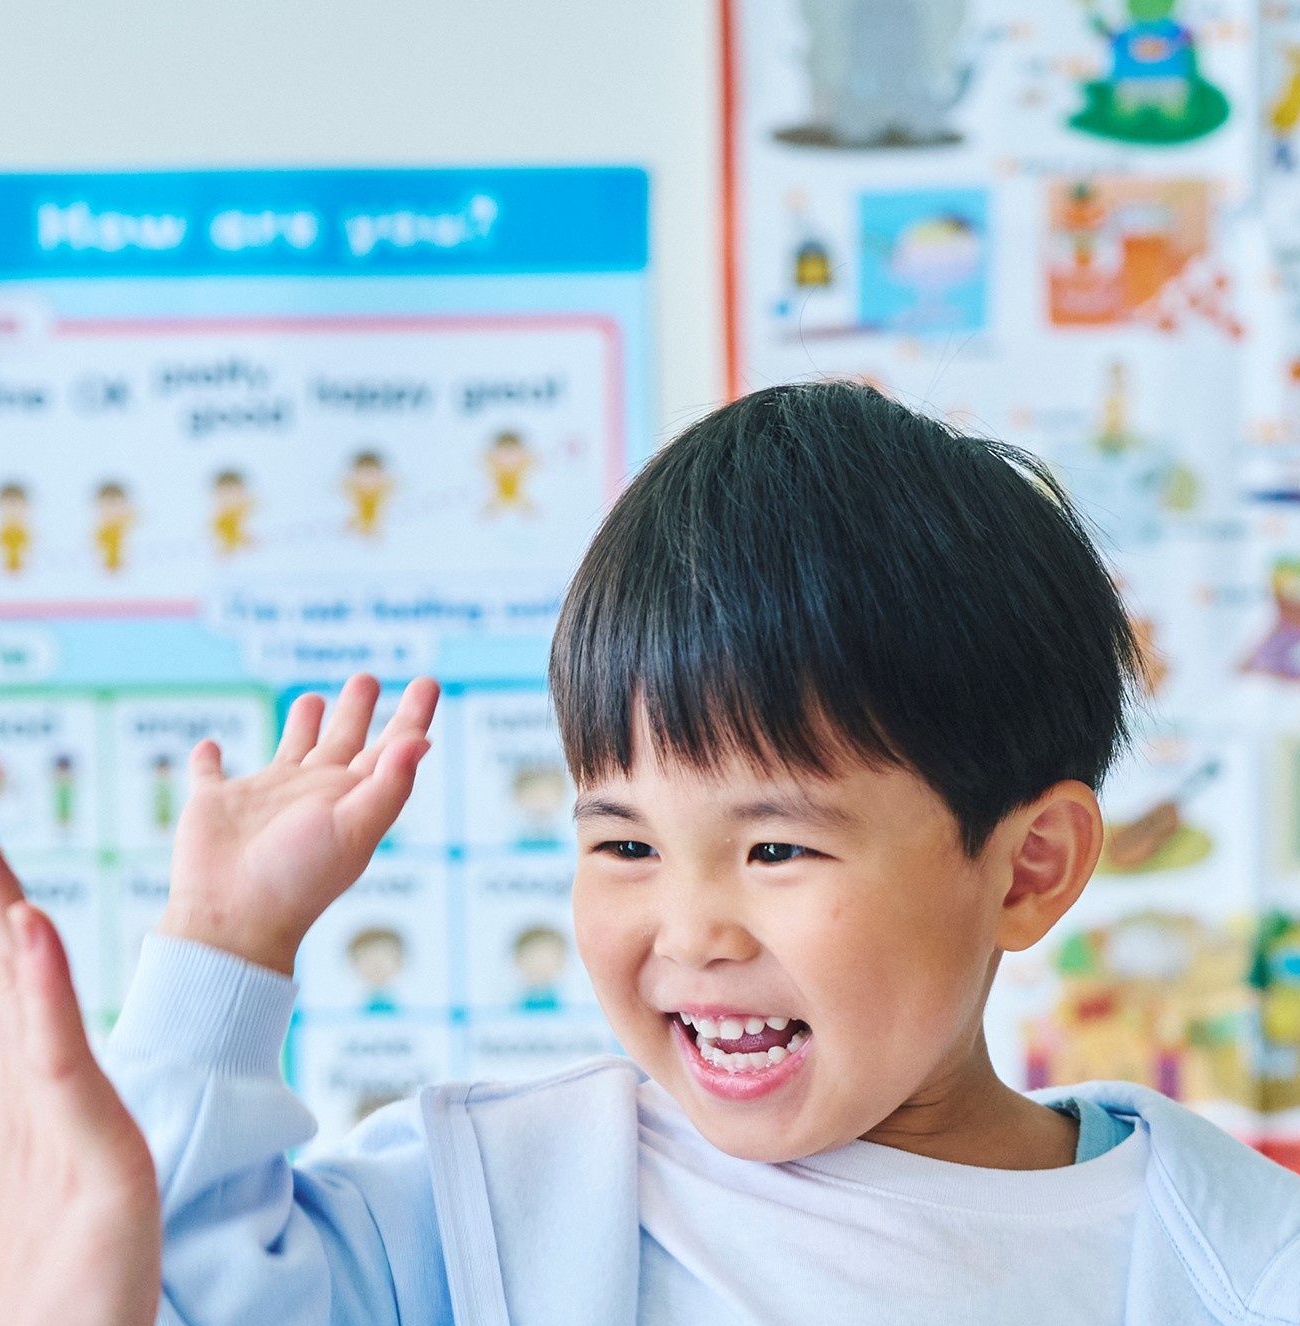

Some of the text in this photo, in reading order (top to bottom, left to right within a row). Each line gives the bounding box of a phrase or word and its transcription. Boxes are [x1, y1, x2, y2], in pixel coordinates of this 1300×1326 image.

[36, 196, 498, 257] How are you?
